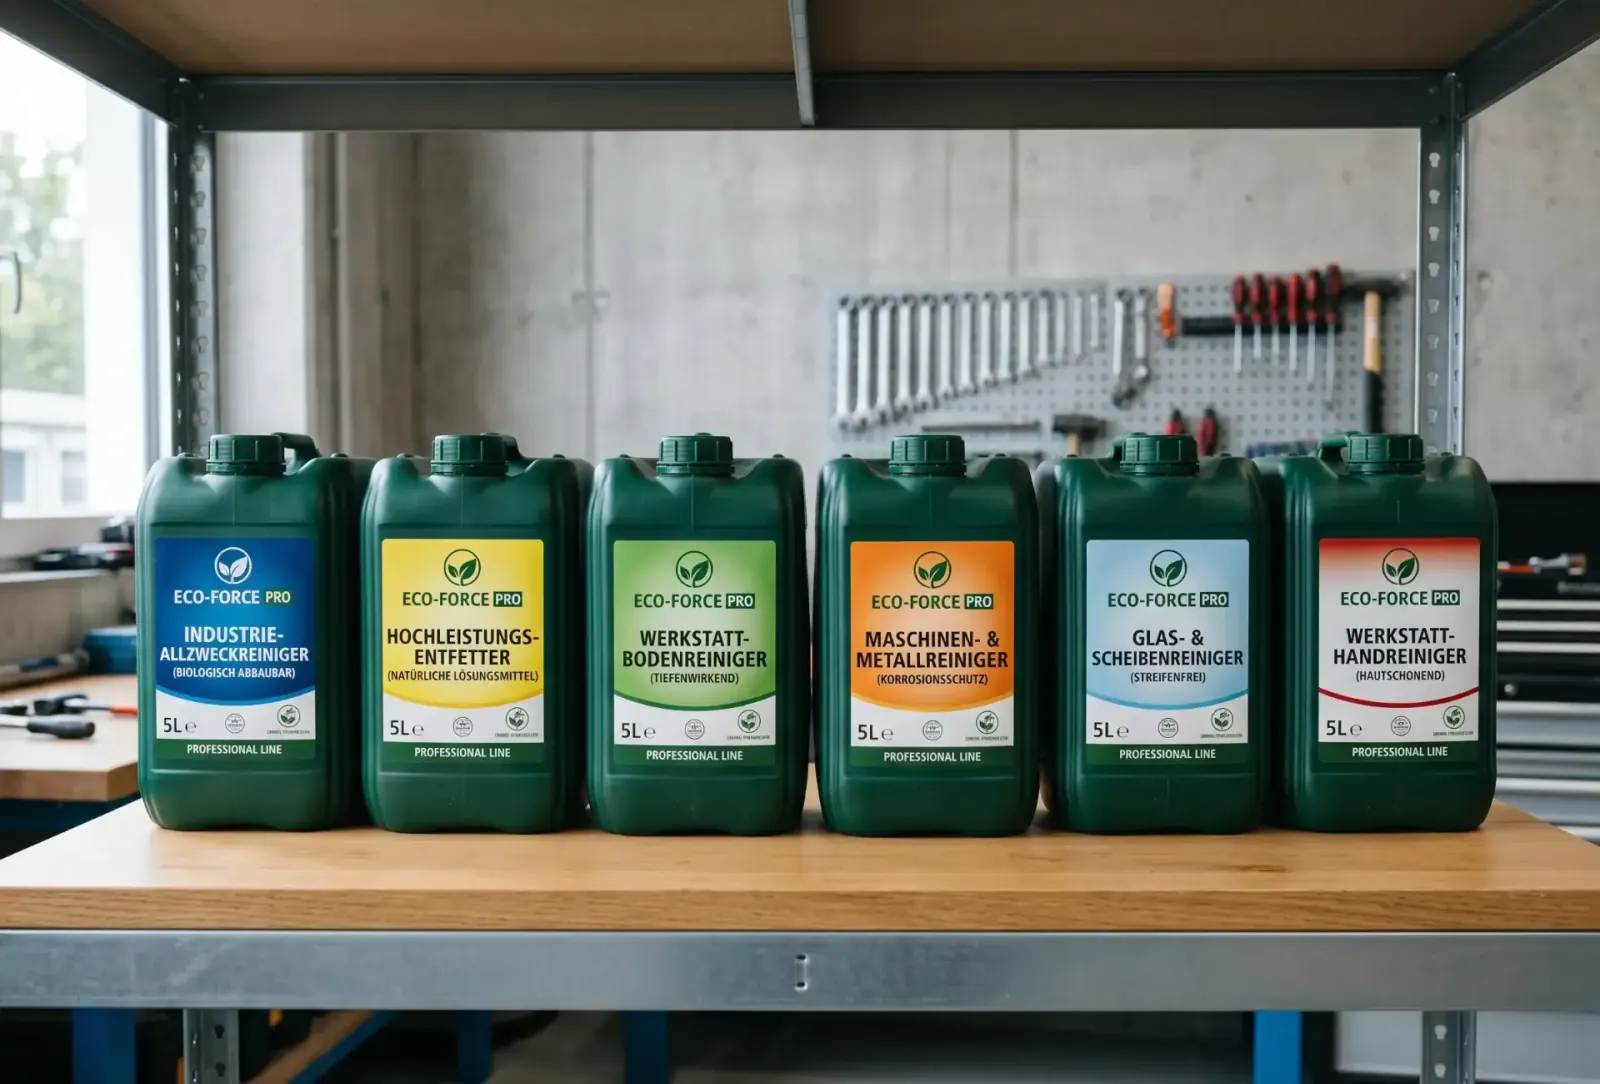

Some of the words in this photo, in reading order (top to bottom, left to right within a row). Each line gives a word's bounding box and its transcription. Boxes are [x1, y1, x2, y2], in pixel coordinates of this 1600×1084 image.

[174, 590, 260, 604] ECO-FORCE
[265, 591, 290, 603] PRO
[403, 592, 489, 606] ECO-FORCE
[495, 594, 521, 605] PRO
[634, 594, 722, 608] ECO-FORCE
[728, 596, 753, 607] PRO
[872, 595, 960, 609] ECO-FORCE
[966, 596, 992, 607] PRO
[1108, 593, 1196, 607] ECO-FORCE
[1202, 594, 1227, 605] PRO
[1341, 592, 1428, 606] ECO-FORCE
[1434, 592, 1458, 603] PRO
[185, 626, 284, 642] INDUSTRIE-
[388, 629, 539, 645] HOCHLEISTUNGS-
[640, 631, 749, 646] WERKSTATT-
[866, 631, 980, 647] MASCHINEN-
[987, 631, 999, 647] &
[1133, 630, 1185, 646] GLAS-
[1192, 630, 1204, 645] &
[1347, 628, 1454, 644] WERKSTATT-
[160, 647, 309, 662] ALLZWECKREINIGER
[415, 649, 510, 665] ENTFETTER
[623, 651, 767, 667] BODENREINIGER
[857, 652, 1008, 668] METALLREINIGER
[1092, 650, 1243, 666] SCHEIBENREINIGER
[1334, 648, 1466, 664] HANDREINIGER
[173, 667, 235, 678] (BIOLOGISCH
[238, 668, 295, 679] ABBAUBAR)
[388, 669, 451, 682] (NATÜRLICHE
[454, 669, 538, 682] LÖSUNGSMITTEL)
[651, 673, 739, 684] (TIEFENWIRKEND)
[877, 674, 988, 686] (KORROSIONSSCHUTZ)
[1131, 672, 1206, 683] (STREIFENFREI)
[1356, 670, 1445, 682] (HAUTSCHONEND)
[163, 718, 182, 733] 5L
[390, 720, 409, 735] 5L
[621, 723, 641, 738] 5L
[858, 725, 878, 740] 5L
[1094, 722, 1113, 737] 5L
[1326, 720, 1346, 736] 5L
[187, 745, 257, 754] PROFESSIONAL
[261, 745, 282, 754] LINE
[415, 748, 486, 757] PROFESSIONAL
[490, 748, 510, 757] LINE
[647, 751, 718, 760] PROFESSIONAL
[722, 751, 743, 760] LINE
[884, 752, 956, 761] PROFESSIONAL
[960, 752, 981, 761] LINE
[1120, 749, 1192, 759] PROFESSIONAL
[1195, 749, 1216, 758] LINE
[1352, 747, 1424, 757] PROFESSIONAL
[1427, 747, 1448, 756] LINE
